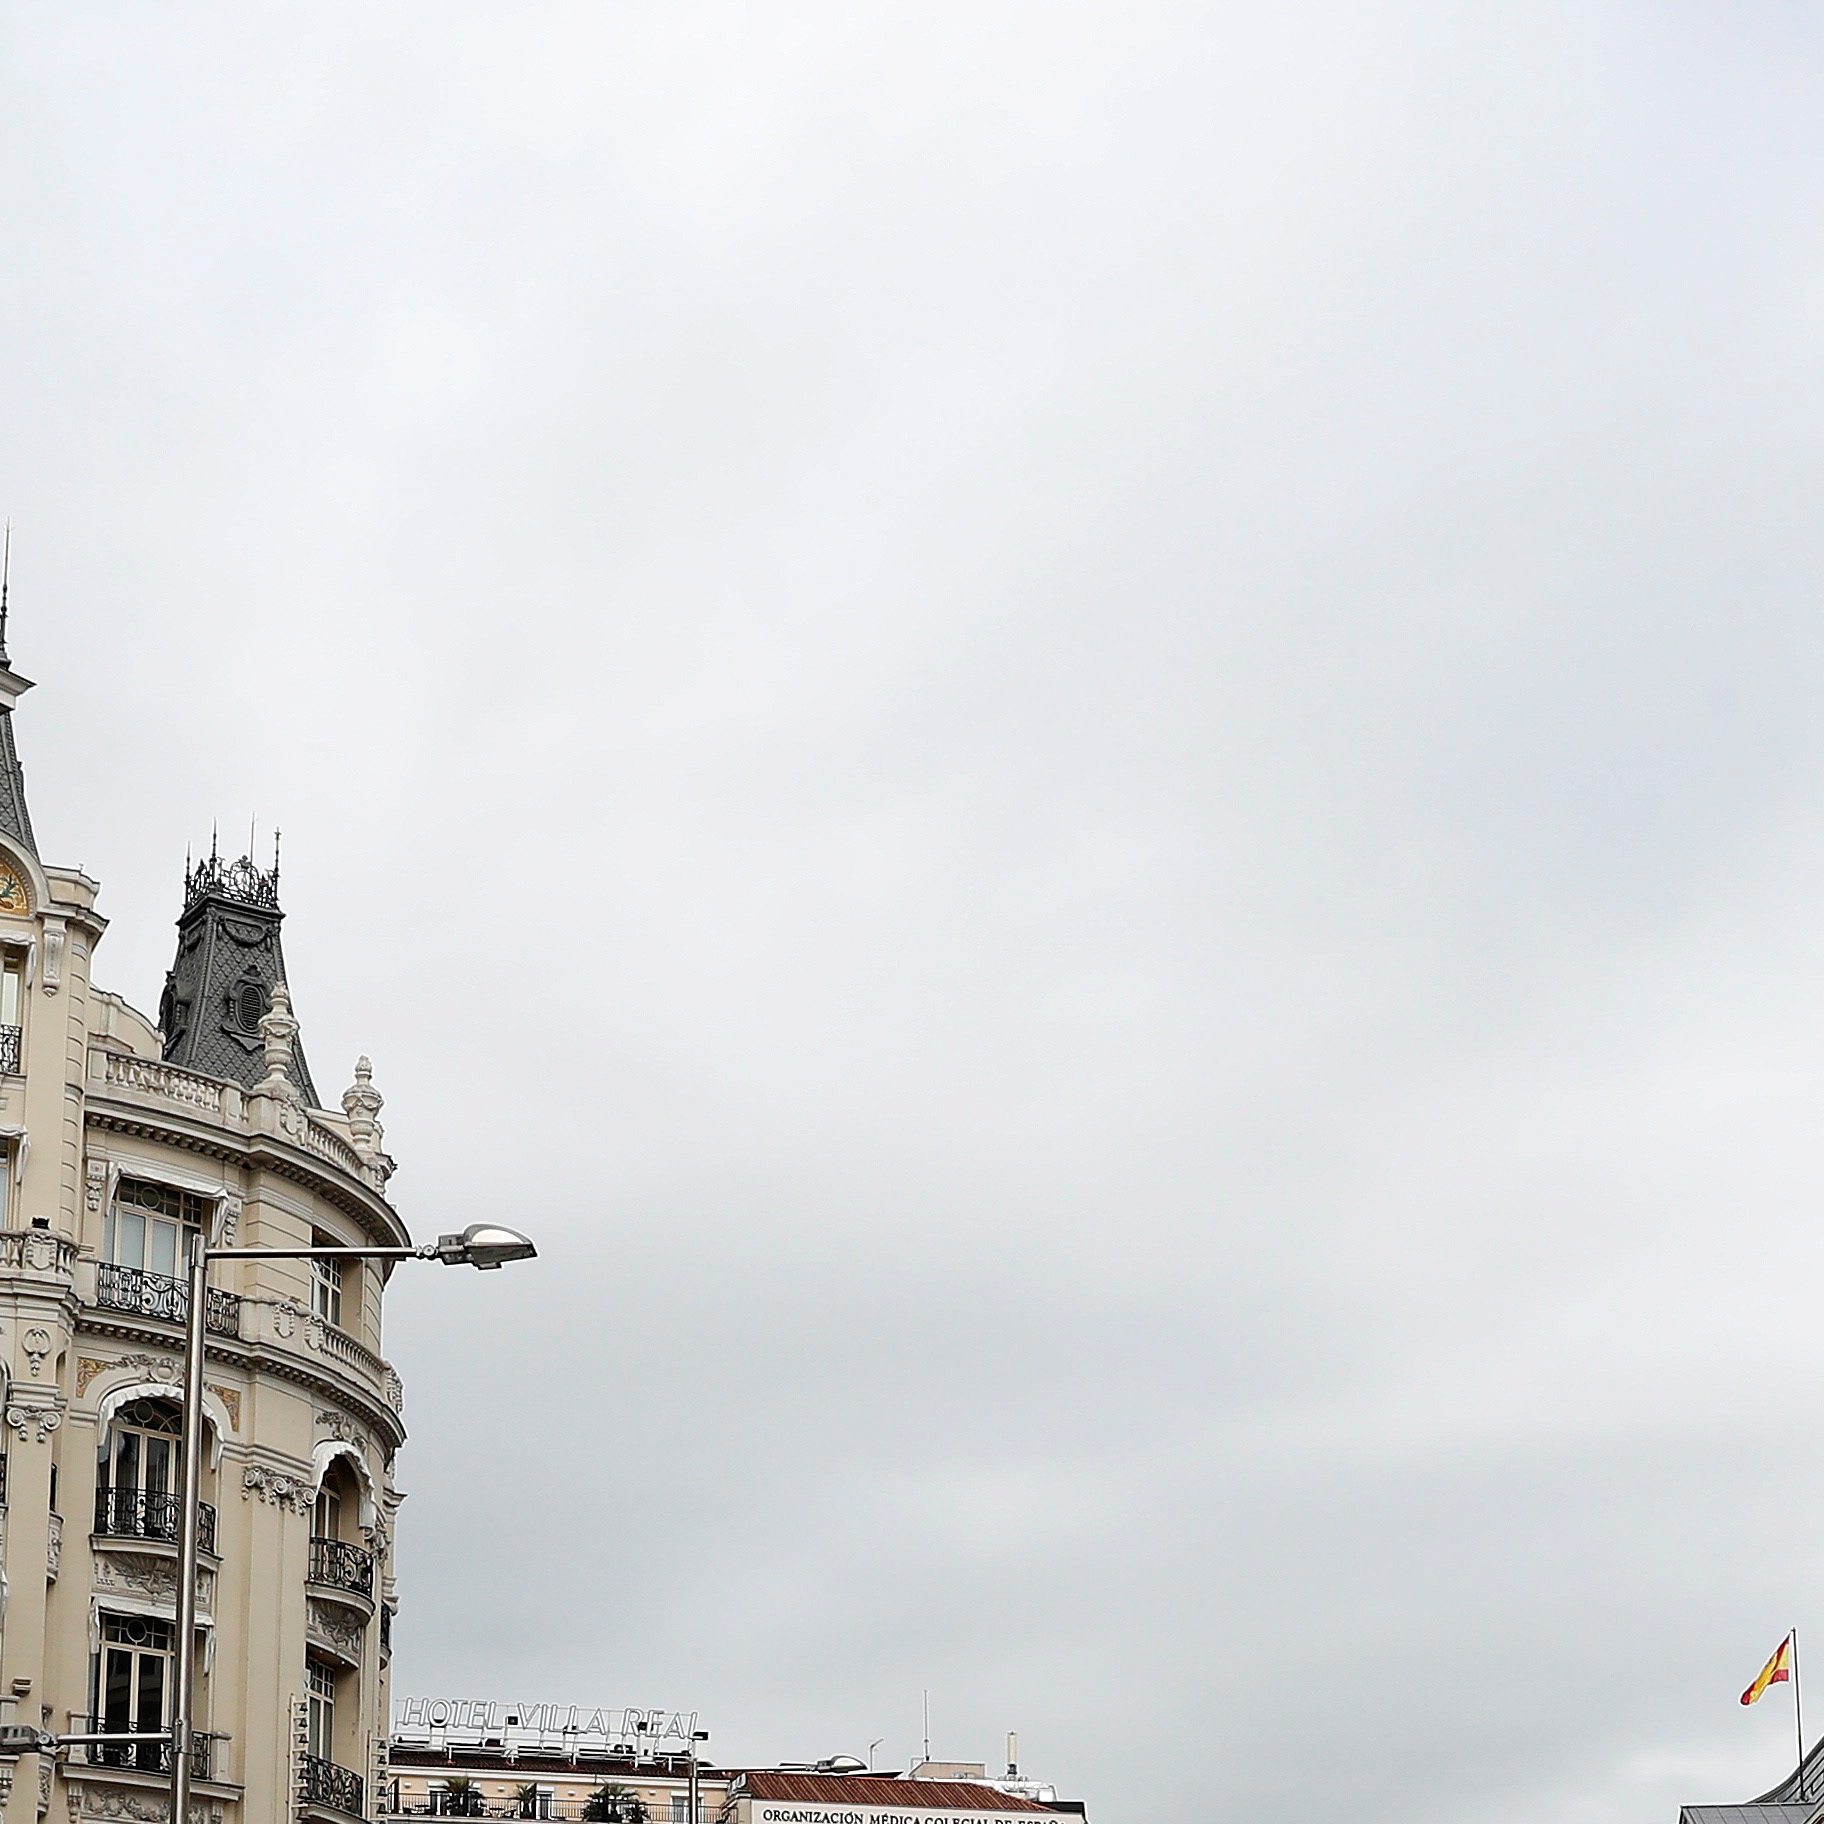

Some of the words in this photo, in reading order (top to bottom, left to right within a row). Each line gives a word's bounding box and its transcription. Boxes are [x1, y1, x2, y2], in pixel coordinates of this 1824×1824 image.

[403, 1697, 503, 1730] HOTEL
[516, 1702, 607, 1736] VILLA
[622, 1708, 704, 1740] REAL
